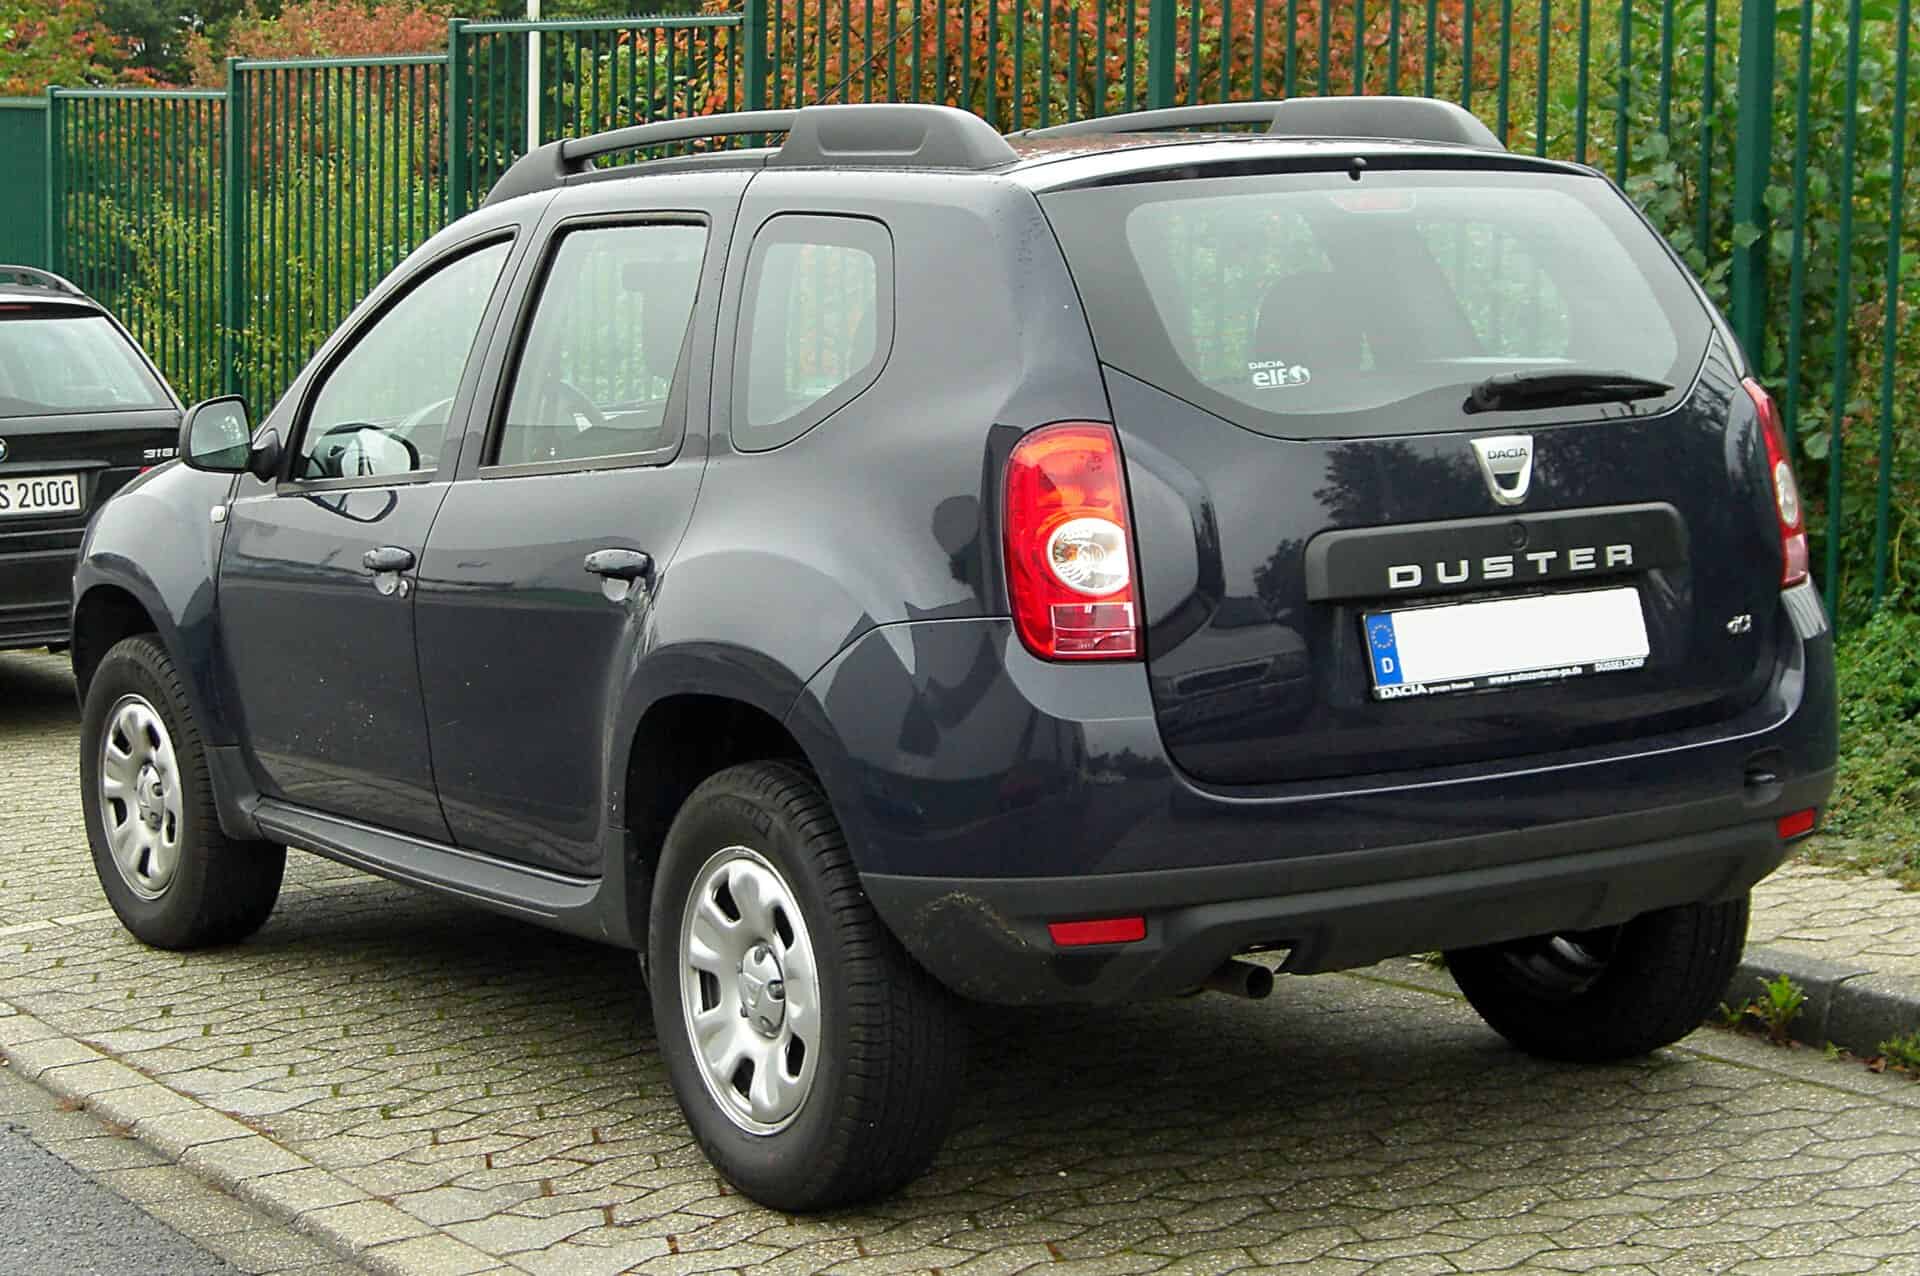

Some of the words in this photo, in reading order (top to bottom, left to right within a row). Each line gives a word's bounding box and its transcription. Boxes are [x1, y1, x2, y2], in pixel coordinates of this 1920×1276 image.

[1253, 368, 1288, 386] elf
[1487, 447, 1528, 460] DACIA
[18, 480, 75, 508] 2000
[1387, 543, 1634, 589] DUSTER
[1382, 657, 1394, 673] D
[1380, 683, 1428, 699] DACIA
